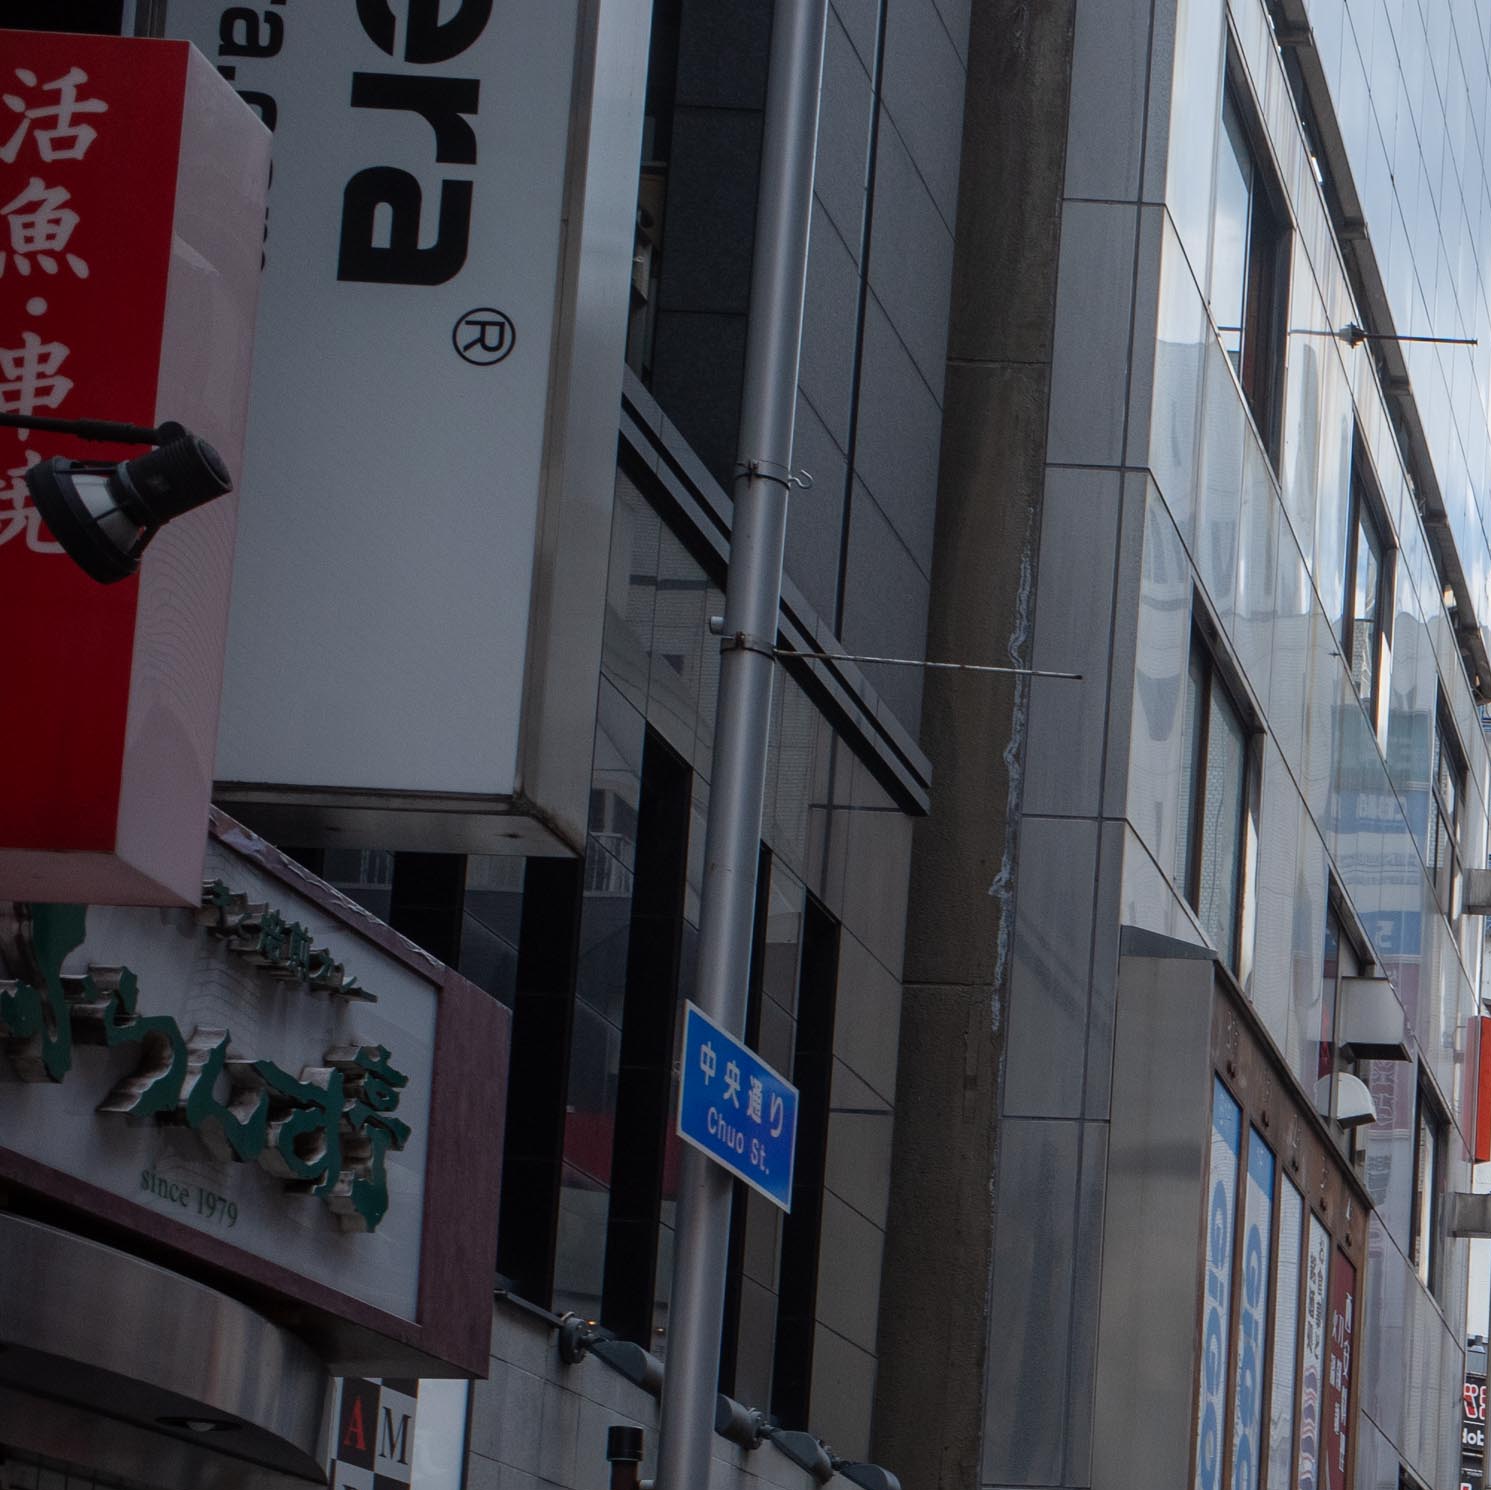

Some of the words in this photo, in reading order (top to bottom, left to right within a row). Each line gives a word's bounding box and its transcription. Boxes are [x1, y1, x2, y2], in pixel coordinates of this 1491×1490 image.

[699, 1040, 784, 1138] 中央通り
[707, 1106, 744, 1154] Chuo
[751, 1137, 770, 1175] St.
[141, 1167, 190, 1207] since
[199, 1188, 239, 1228] 1979
